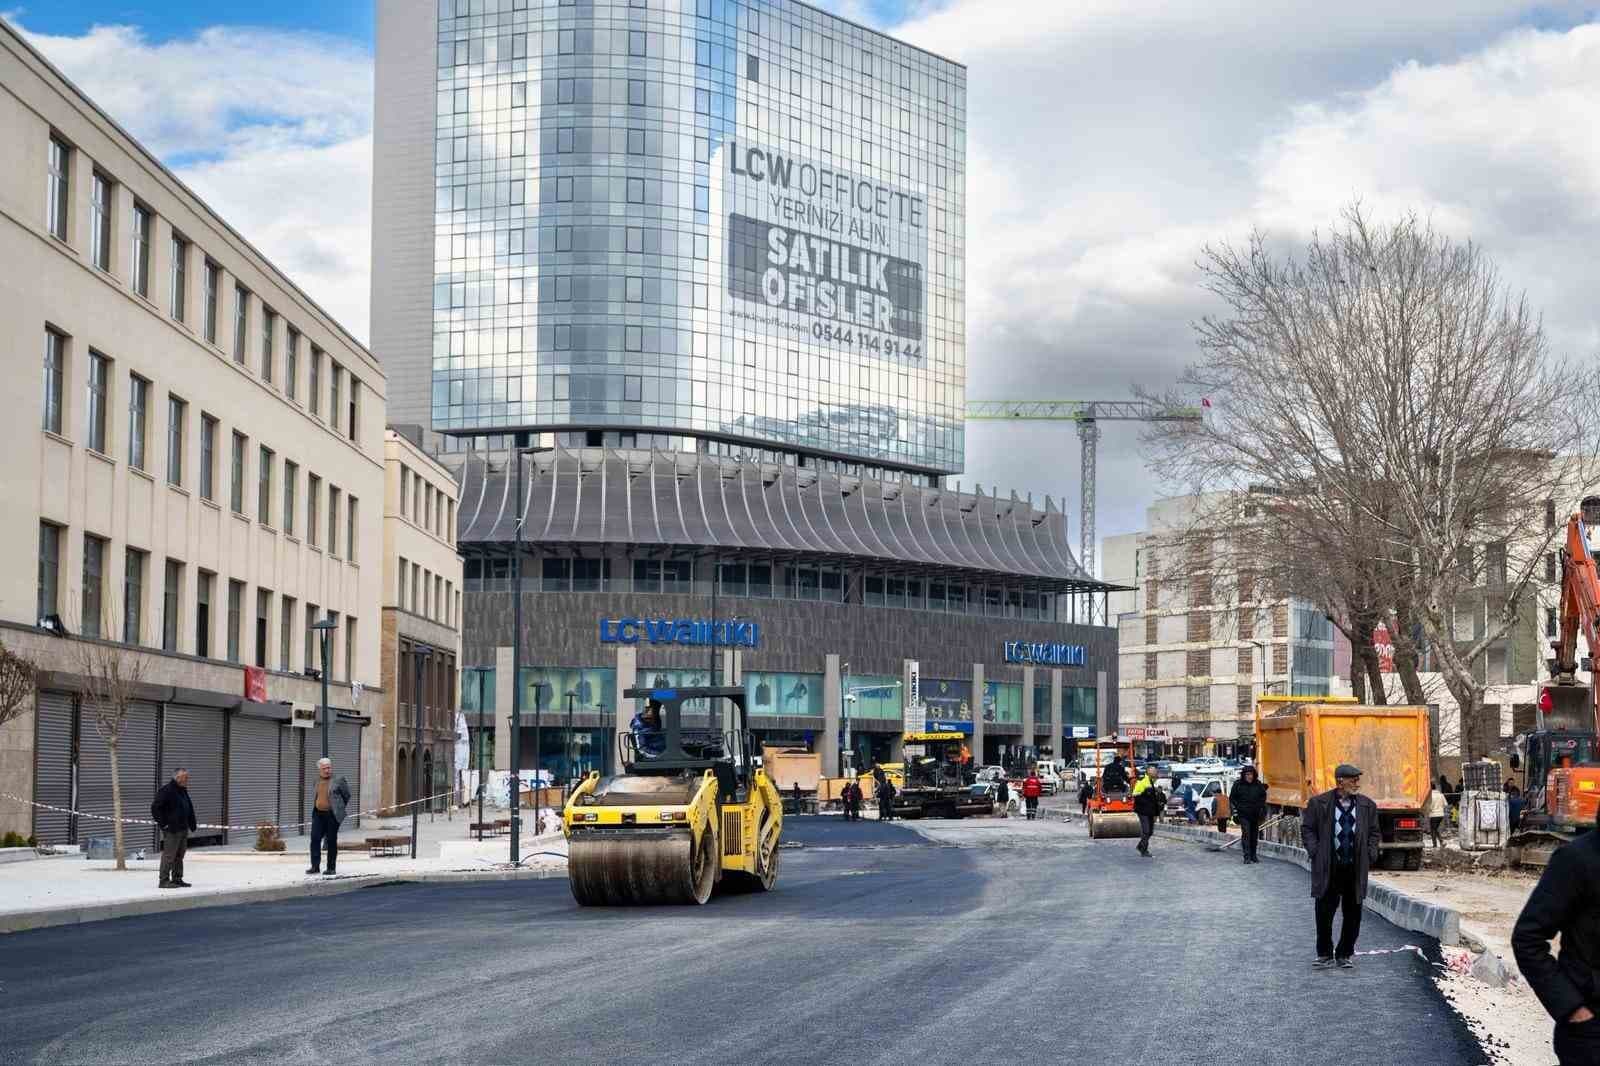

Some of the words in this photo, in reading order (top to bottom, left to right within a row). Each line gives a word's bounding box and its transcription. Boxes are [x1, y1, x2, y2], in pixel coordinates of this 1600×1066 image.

[730, 141, 793, 189] LCW
[800, 163, 923, 229] OFFICE'TE
[767, 226, 889, 293] SATILIK
[761, 267, 894, 335] OFİSLER
[812, 321, 854, 345] 0544
[857, 332, 880, 352] 114
[600, 617, 640, 644] LC
[1003, 640, 1024, 662] LC
